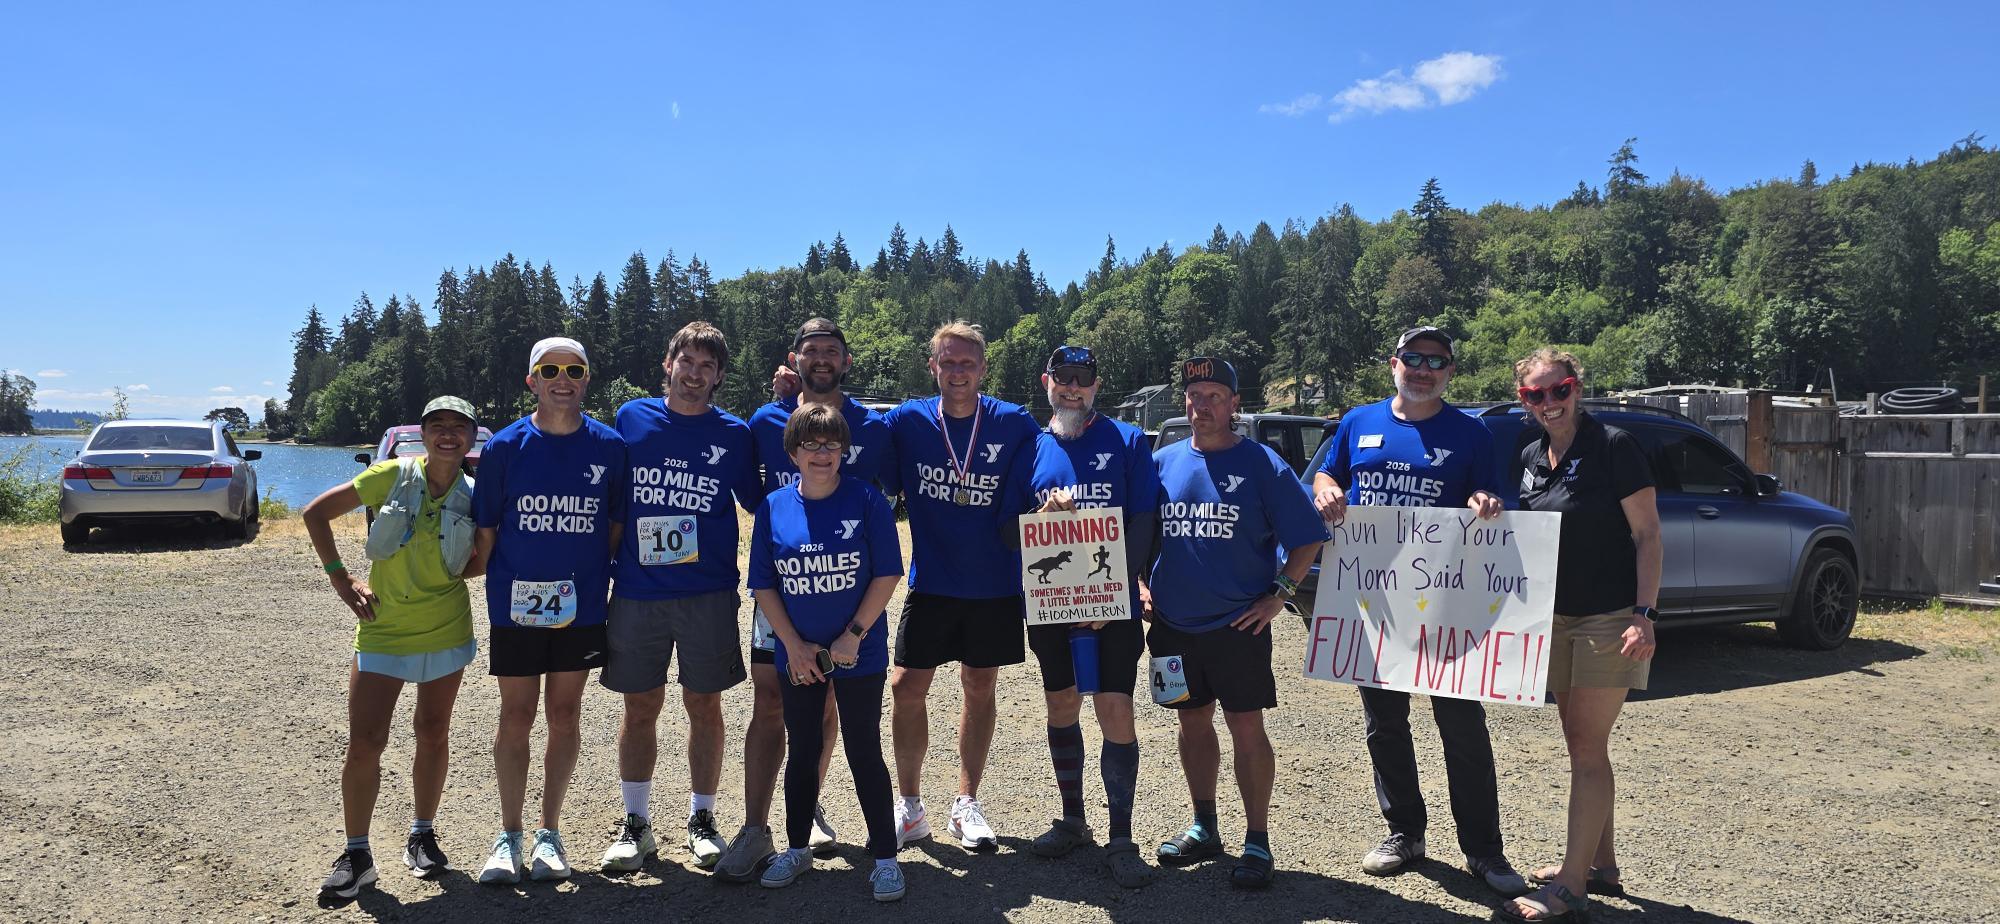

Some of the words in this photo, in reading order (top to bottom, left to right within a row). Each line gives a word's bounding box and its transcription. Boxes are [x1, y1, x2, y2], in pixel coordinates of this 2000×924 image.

[707, 445, 729, 465] Y
[846, 445, 864, 465] Y
[986, 443, 1004, 463] Y
[1095, 452, 1114, 470] Y
[1430, 447, 1453, 467] Y
[663, 458, 688, 469] 2026
[916, 463, 945, 482] 100
[1385, 461, 1411, 471] 2026
[590, 464, 607, 485] Y
[632, 466, 662, 485] 100
[663, 470, 720, 496] MILES
[1225, 474, 1246, 492] Y
[1357, 471, 1384, 489] 100
[1386, 473, 1444, 498] MILES
[633, 486, 665, 506] FOR
[668, 489, 713, 513] KIDS
[918, 480, 950, 501] FOR
[1063, 483, 1112, 500] MILES
[1360, 490, 1388, 507] FOR
[550, 495, 600, 515] MILES
[1161, 502, 1187, 519] 100
[1188, 502, 1240, 522] MILES
[519, 514, 554, 532] FOR
[556, 515, 595, 534] KIDS
[840, 519, 861, 540] Y
[1024, 516, 1120, 548] RUNNING
[1162, 520, 1192, 537] FOR
[1195, 521, 1234, 539] KIDS
[1332, 514, 1377, 547] Run
[1397, 510, 1443, 544] like
[1458, 516, 1515, 546] Your
[653, 530, 683, 552] 10
[800, 543, 824, 552] 2026
[804, 551, 861, 574] MILES
[782, 576, 812, 595] FOR
[813, 570, 857, 594] KIDS
[1337, 556, 1398, 591] Mom
[1411, 557, 1465, 591] Said
[1484, 562, 1529, 594] Your
[1030, 586, 1071, 598] SOMETIMES
[1074, 584, 1086, 595] WE
[1089, 584, 1102, 594] ALL
[1104, 582, 1123, 592] NEED
[527, 595, 562, 616] 24
[1040, 598, 1046, 608] A
[1048, 596, 1071, 608] LITTLE
[1073, 594, 1114, 606] MOTIVATION
[1308, 616, 1390, 685] FULL
[1153, 671, 1166, 692] 4
